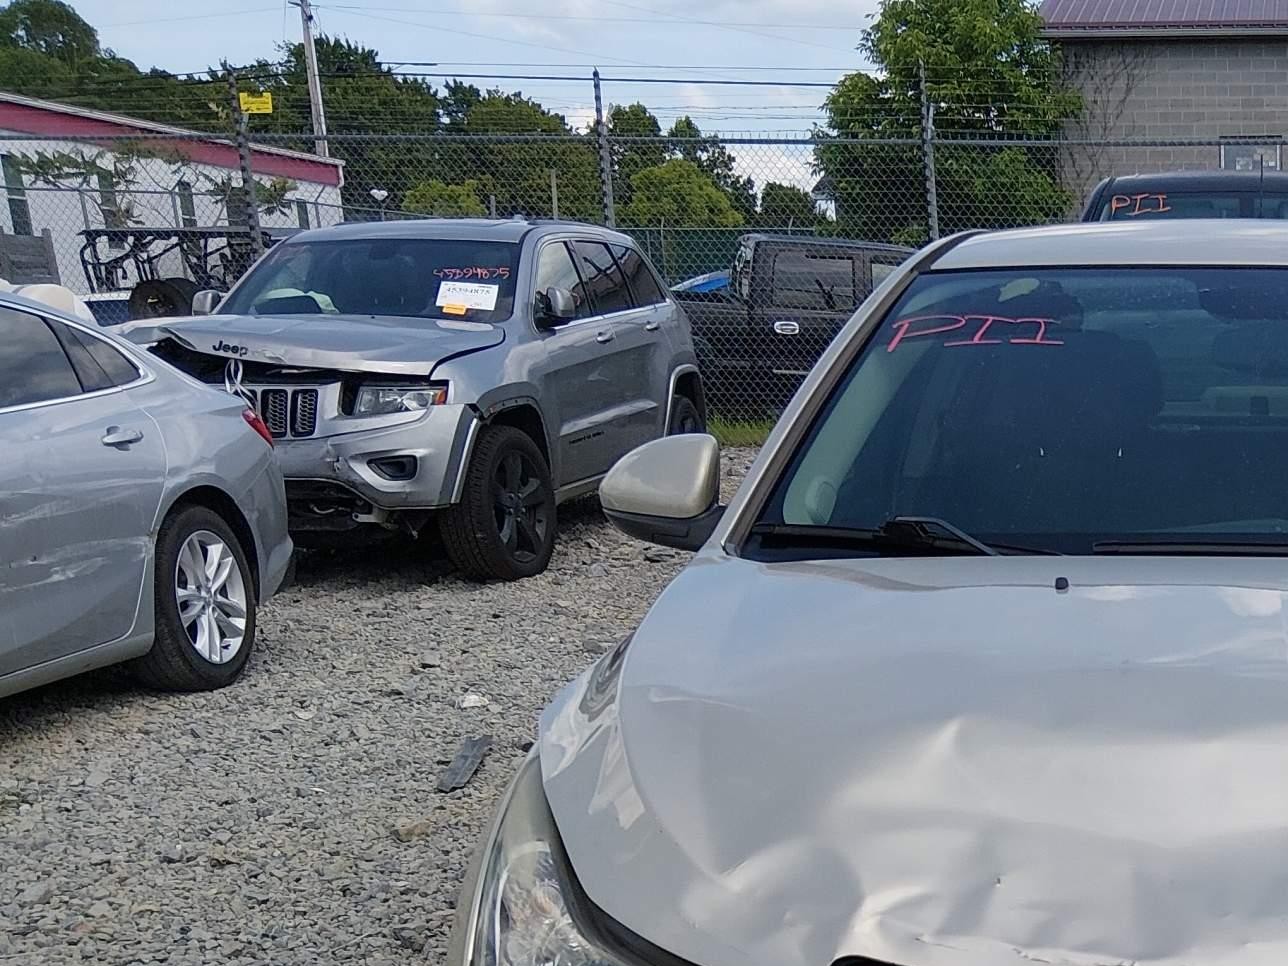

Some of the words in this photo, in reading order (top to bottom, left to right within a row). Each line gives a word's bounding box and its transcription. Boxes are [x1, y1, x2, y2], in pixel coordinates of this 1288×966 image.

[1111, 193, 1172, 216] PII
[887, 314, 1065, 353] PII
[212, 340, 249, 357] Jeep
